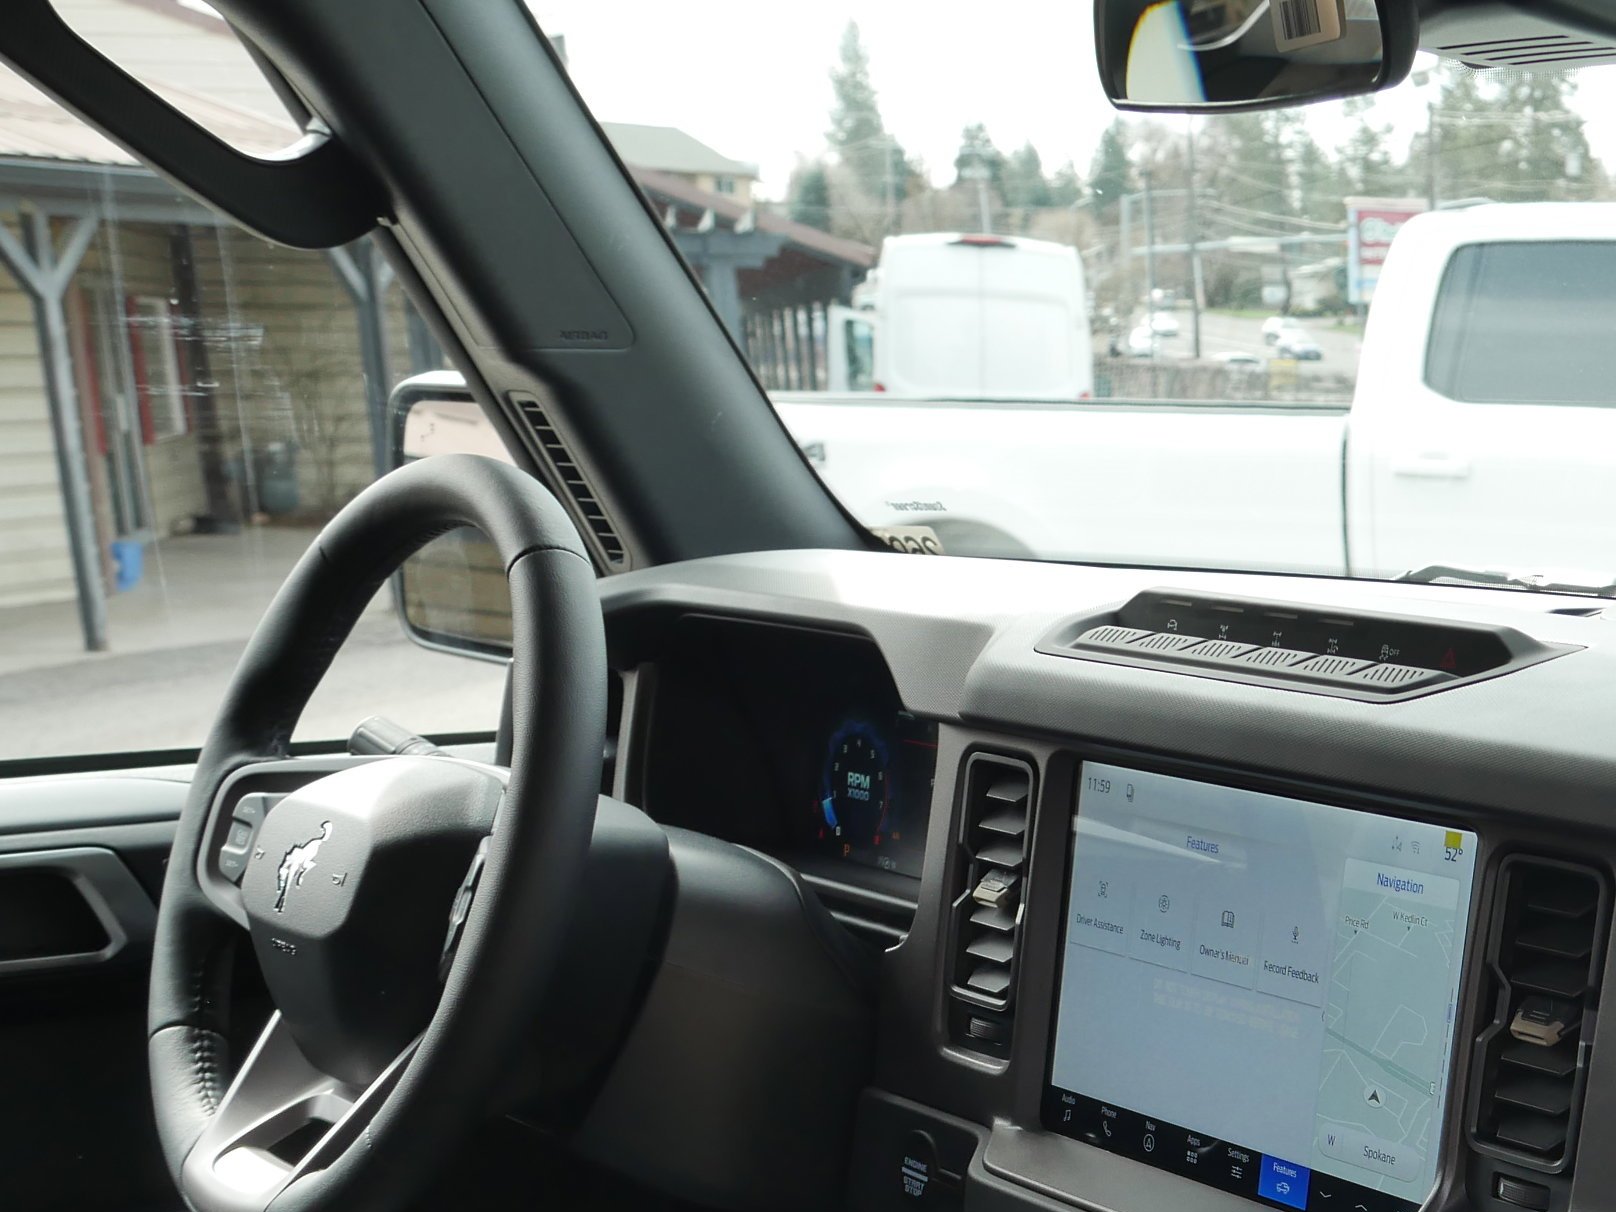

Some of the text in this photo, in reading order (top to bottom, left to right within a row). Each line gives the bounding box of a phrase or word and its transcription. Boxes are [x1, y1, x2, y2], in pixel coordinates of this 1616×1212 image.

[848, 772, 870, 788] RPM
[1087, 777, 1111, 794] 11:59
[848, 787, 869, 800] X1000
[1187, 836, 1219, 854] Features
[1444, 847, 1464, 862] 52°
[1377, 873, 1424, 895] Navigation
[1077, 913, 1124, 935] Driver Assistance
[1345, 915, 1369, 929] Price Rd
[1140, 929, 1181, 950] Zone Lighting
[1264, 960, 1319, 984] Record Feedback
[1062, 1093, 1076, 1105] Audio
[1101, 1106, 1117, 1119] Phone
[1145, 1120, 1156, 1132] Nav
[1187, 1134, 1201, 1148] Apps
[1227, 1147, 1250, 1163] Settings
[1327, 1134, 1396, 1165] W Spokane
[904, 1156, 928, 1173] ENGINE
[1273, 1162, 1297, 1178] Features
[903, 1176, 925, 1190] START
[904, 1184, 923, 1197] STOP
